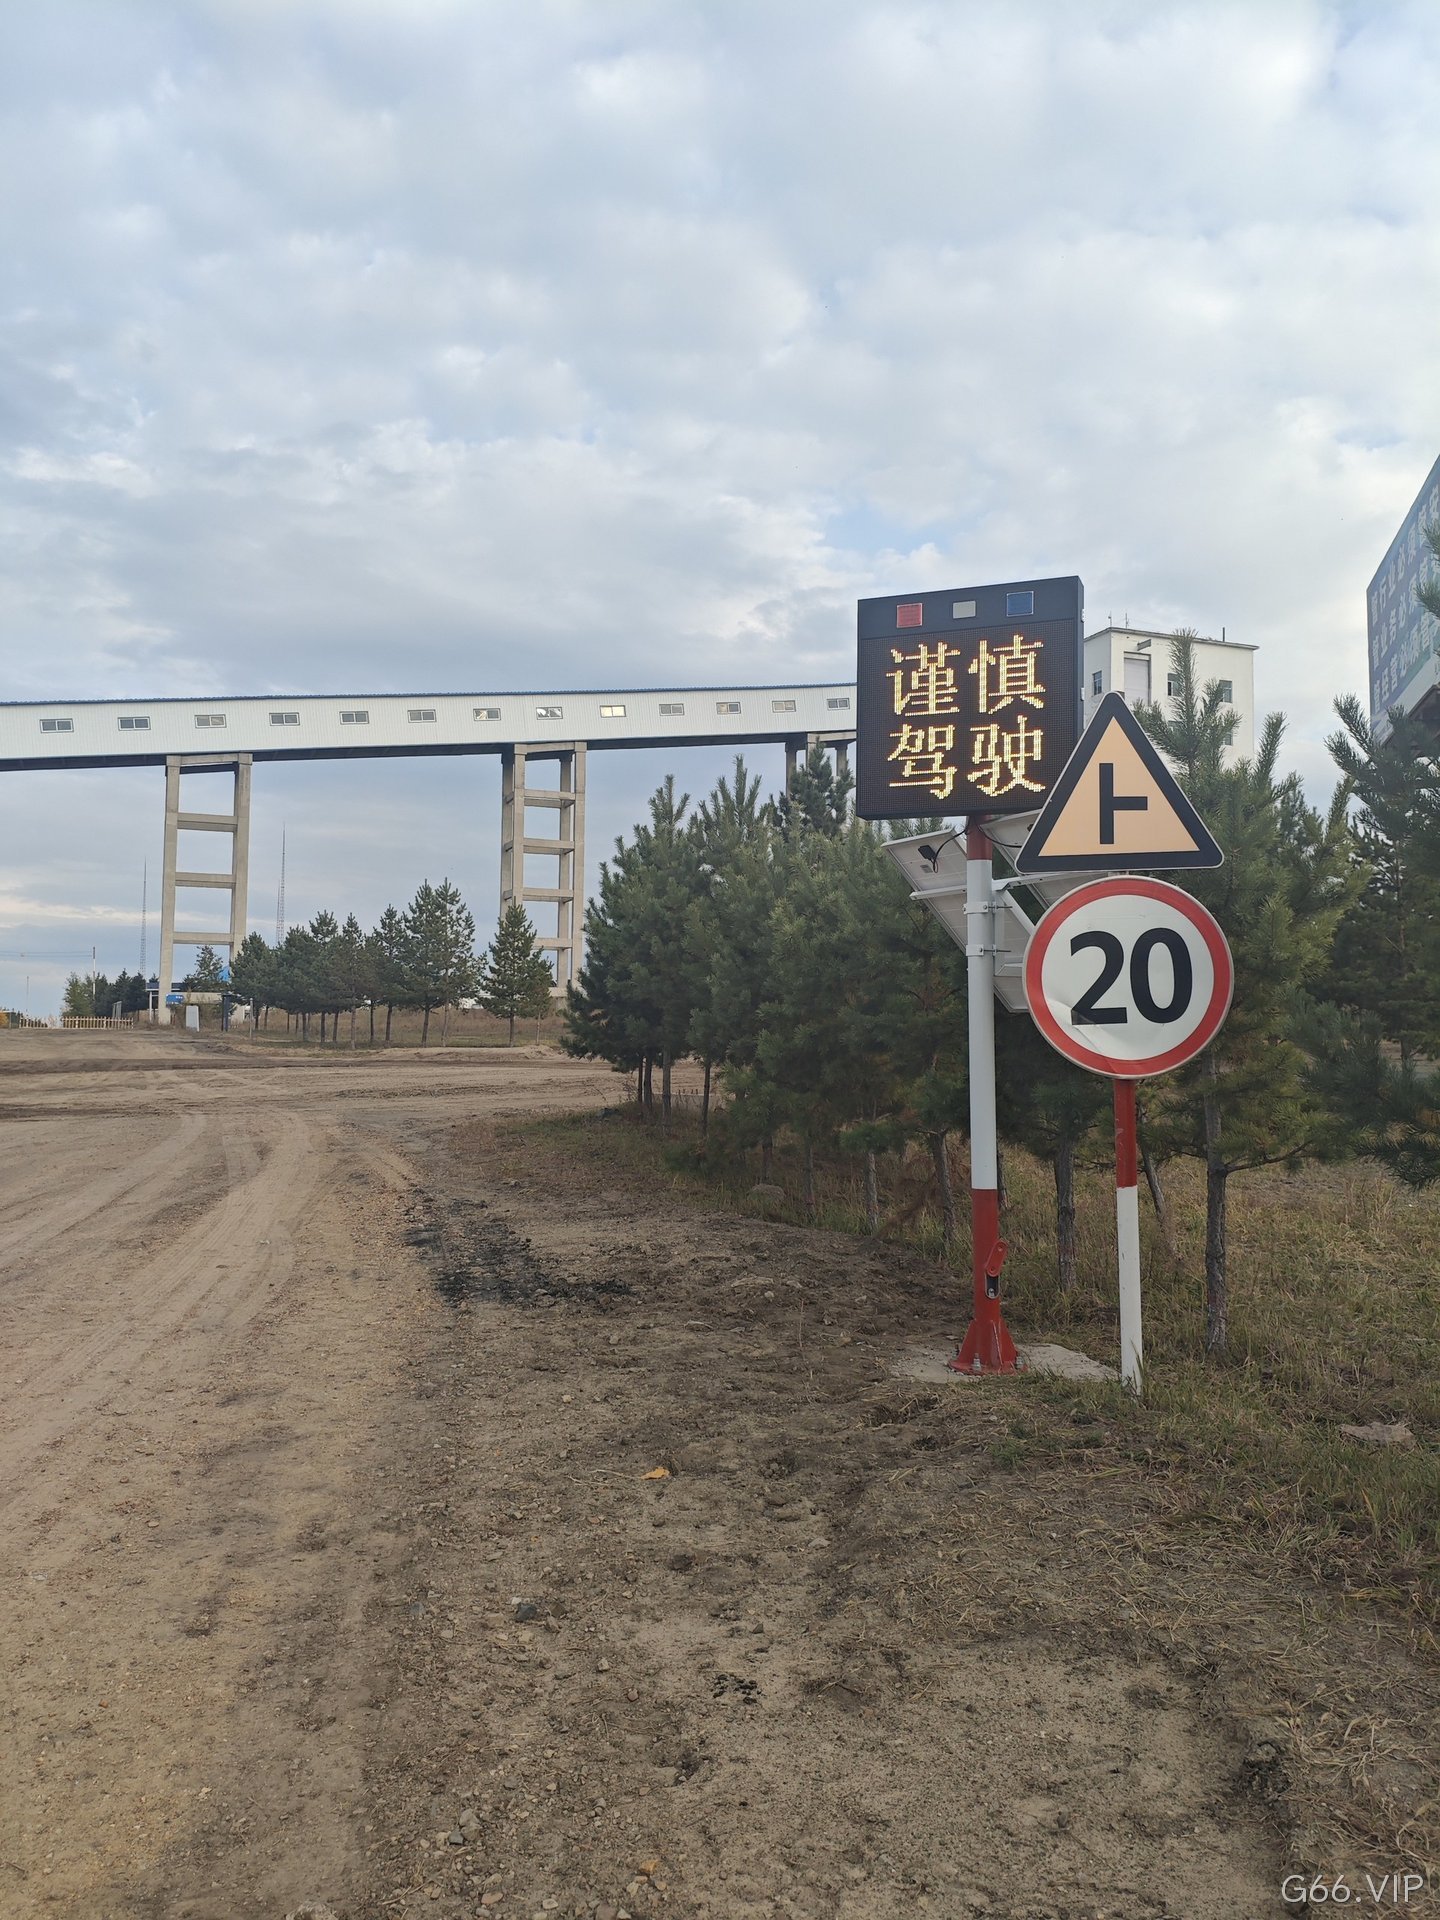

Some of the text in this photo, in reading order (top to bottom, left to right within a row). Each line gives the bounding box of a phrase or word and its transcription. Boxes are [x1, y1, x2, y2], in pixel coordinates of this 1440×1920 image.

[886, 635, 1046, 716] 谨慎
[887, 715, 1046, 799] 驾驶
[1070, 927, 1193, 1025] 20
